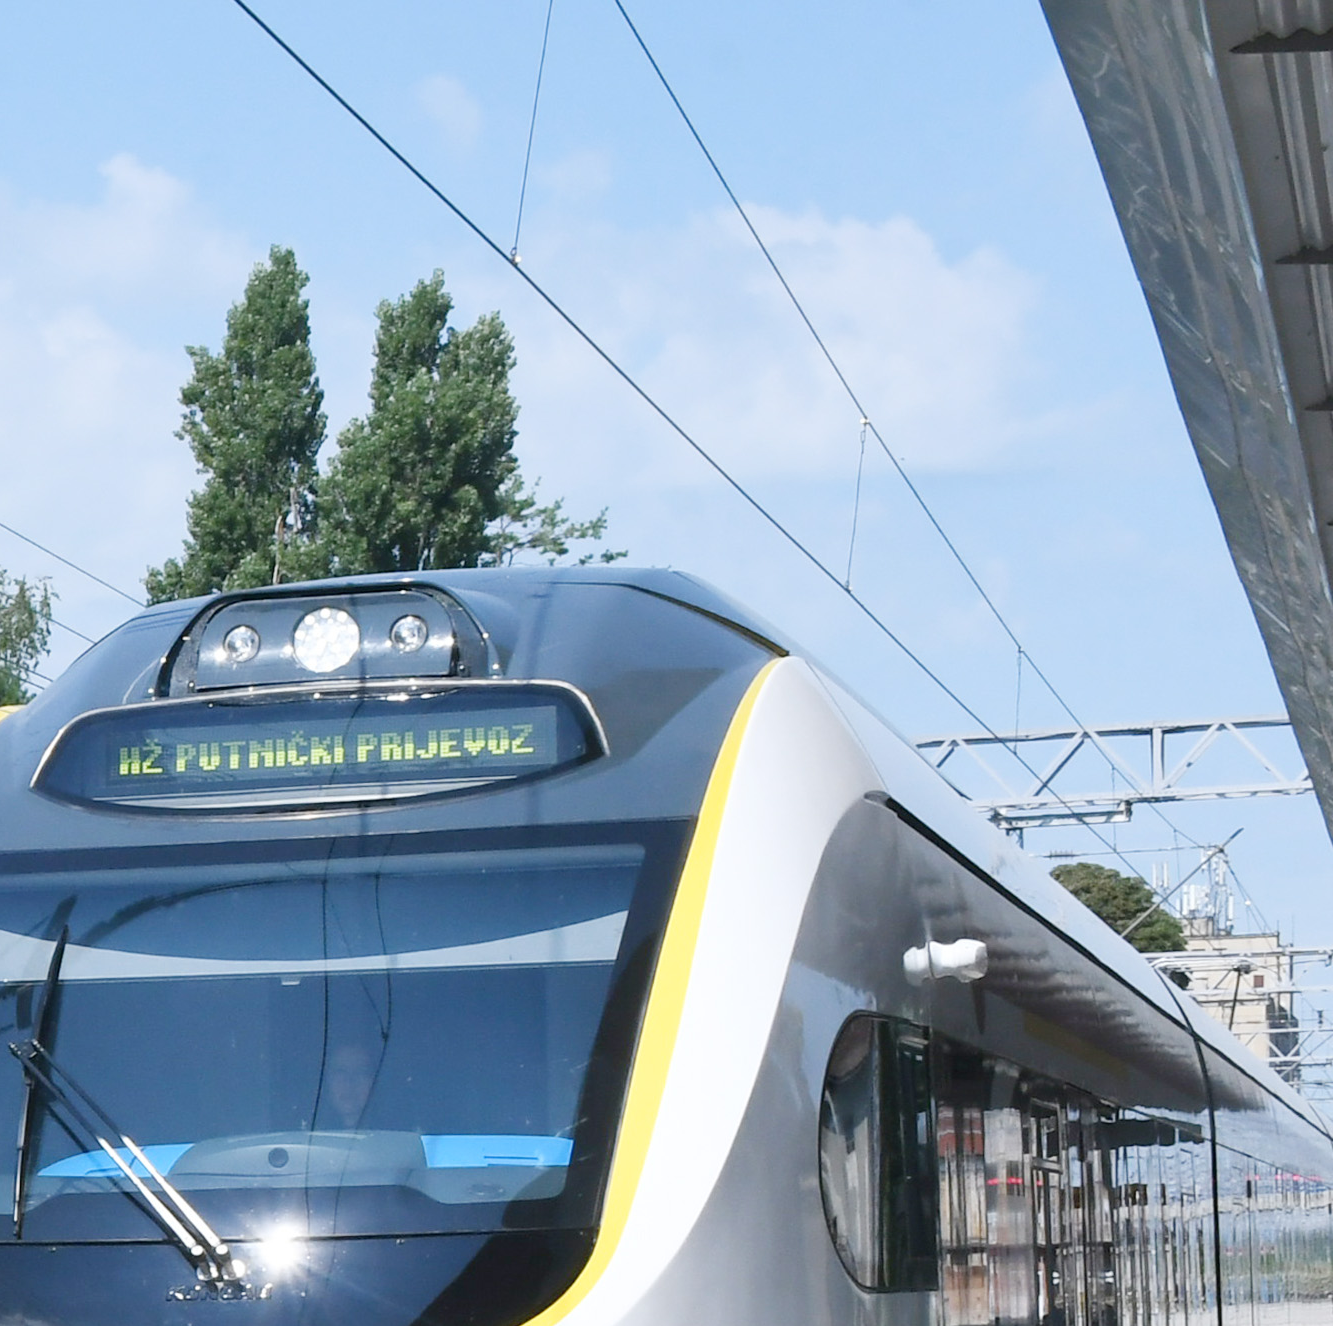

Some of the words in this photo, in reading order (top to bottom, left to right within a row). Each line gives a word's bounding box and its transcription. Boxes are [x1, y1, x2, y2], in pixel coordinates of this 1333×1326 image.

[119, 738, 163, 775] HŽ
[176, 730, 343, 771] PUTNIČKI
[356, 724, 534, 762] PRIJEVOZ
